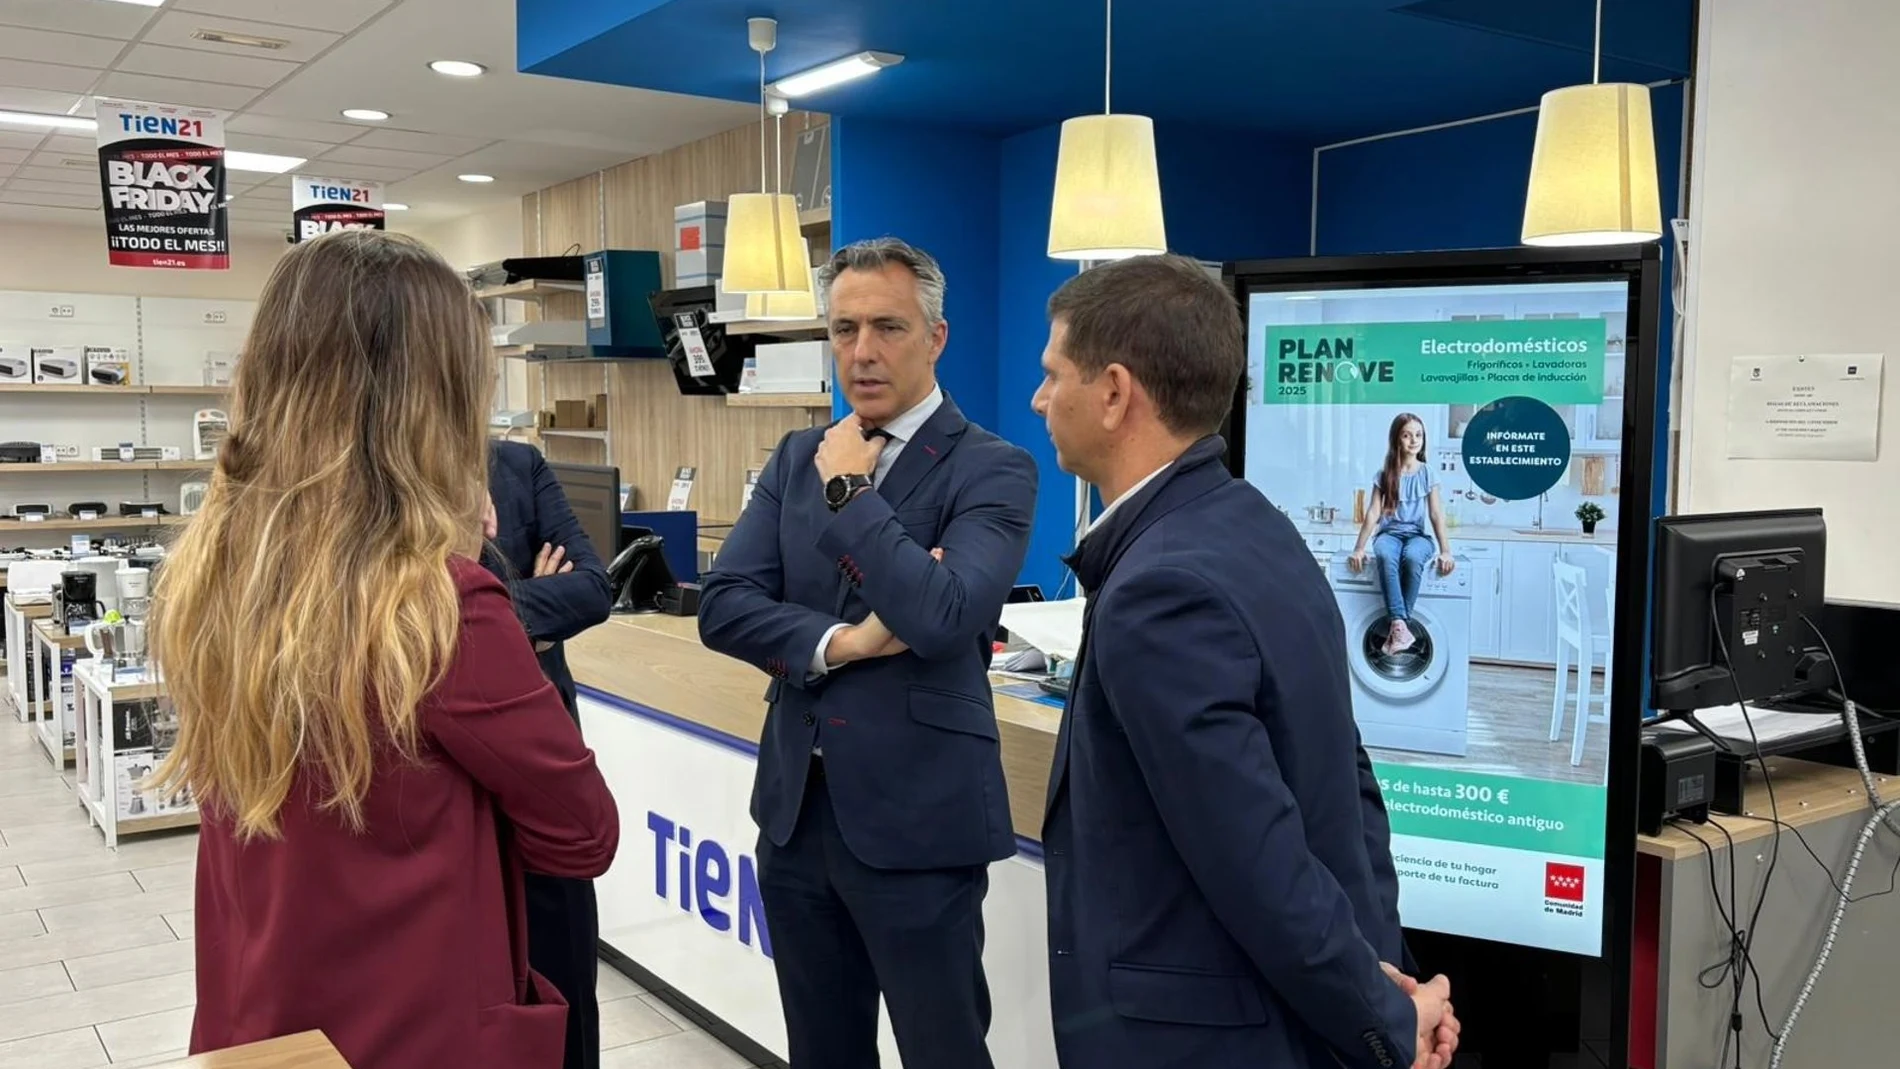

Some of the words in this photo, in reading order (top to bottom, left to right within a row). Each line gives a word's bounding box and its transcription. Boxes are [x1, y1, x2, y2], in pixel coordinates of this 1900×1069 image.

[108, 160, 214, 190] BLACK
[109, 186, 215, 214] FRIDAY
[119, 224, 135, 232] LAS
[137, 225, 176, 234] MEJORES
[177, 226, 215, 235] OFERTAS
[111, 236, 161, 249] ¡¡TODO
[164, 239, 182, 251] EL
[185, 240, 225, 252] MES!!
[153, 259, 186, 267] tien21.es
[1279, 337, 1354, 360] PLAN
[1421, 337, 1588, 355] Electrodomésticos
[1532, 359, 1587, 369] Lavadoras
[1278, 361, 1395, 384] RENOVE
[1421, 373, 1479, 384] Lavavajillas
[1487, 373, 1520, 382] Placas
[1522, 372, 1535, 382] de
[1538, 372, 1587, 382] inducción
[1278, 386, 1307, 395] 2025
[1487, 430, 1546, 441] INFÓRMATE
[1495, 444, 1509, 452] EN
[1511, 444, 1536, 453] ESTE
[1469, 456, 1562, 466] ESTABLECIMIENTO
[1392, 779, 1410, 793] de
[1413, 782, 1452, 798] hasta
[1455, 783, 1492, 802] 300
[1497, 788, 1509, 804] €
[1507, 815, 1564, 832] antiguo
[1393, 854, 1432, 866] ciencia
[1434, 859, 1448, 868] de
[1450, 862, 1462, 870] tu
[1464, 863, 1497, 876] hogar
[1397, 869, 1426, 880] porte
[1428, 872, 1442, 881] de
[1444, 875, 1456, 884] tu
[1458, 876, 1499, 889] factura
[1544, 900, 1583, 910] Comunidad
[1556, 908, 1583, 917] Madrid
